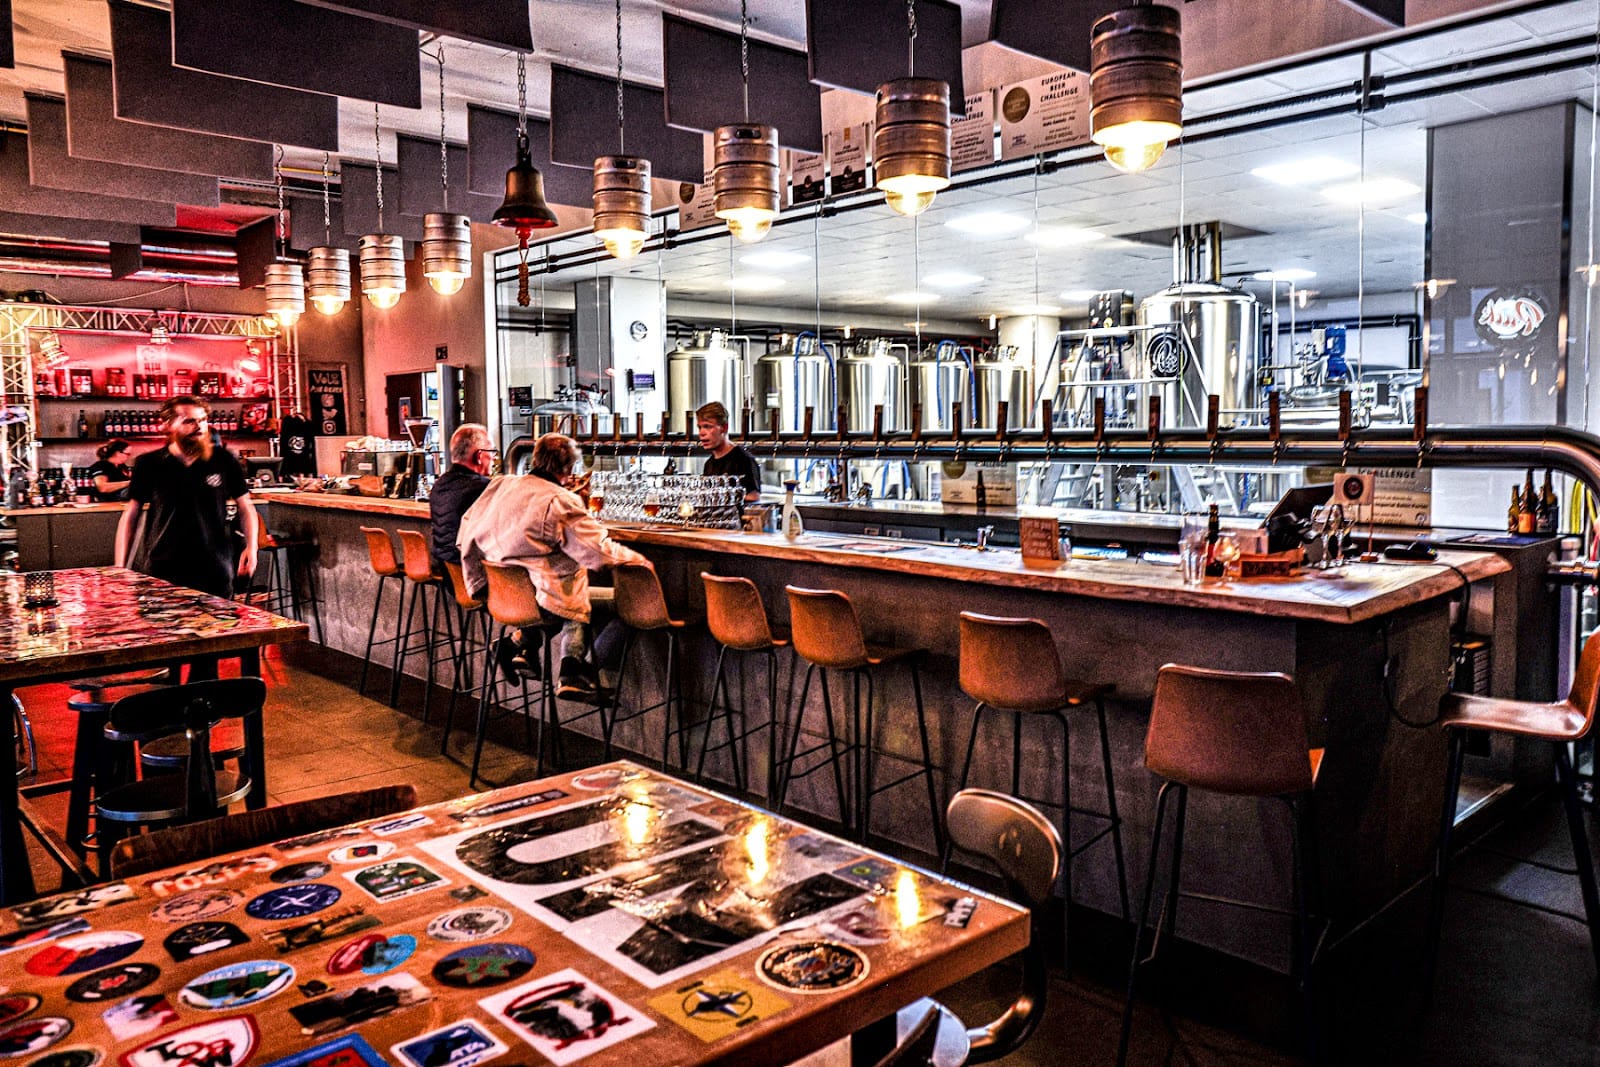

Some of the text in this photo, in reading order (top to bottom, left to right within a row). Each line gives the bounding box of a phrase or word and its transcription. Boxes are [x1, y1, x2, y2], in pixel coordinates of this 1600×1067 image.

[1041, 71, 1077, 86] EUROPEAN
[1040, 86, 1079, 102] CHALLENGE
[1050, 82, 1066, 92] BEER
